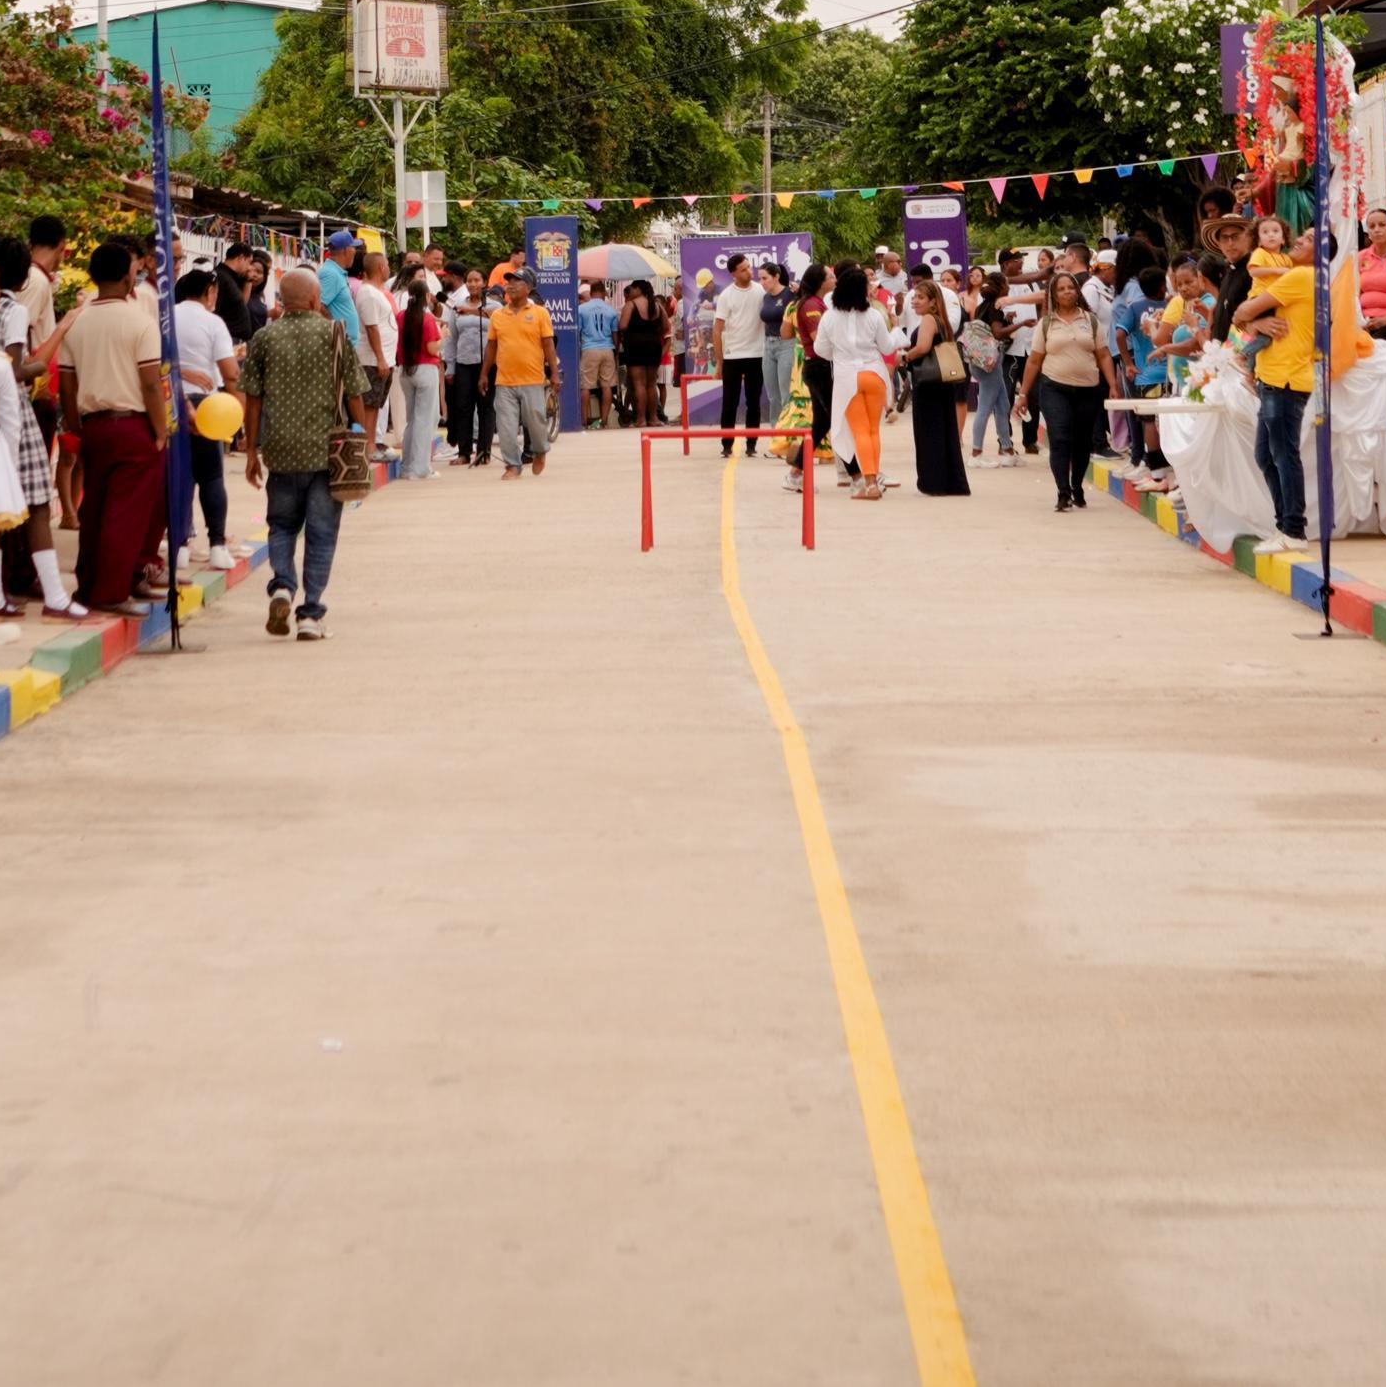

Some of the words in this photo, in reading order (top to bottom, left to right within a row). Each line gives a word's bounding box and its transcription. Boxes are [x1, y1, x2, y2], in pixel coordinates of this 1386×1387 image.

[385, 4, 424, 24] NARANJA
[543, 298, 573, 311] AMIL
[549, 311, 574, 323] ANA
